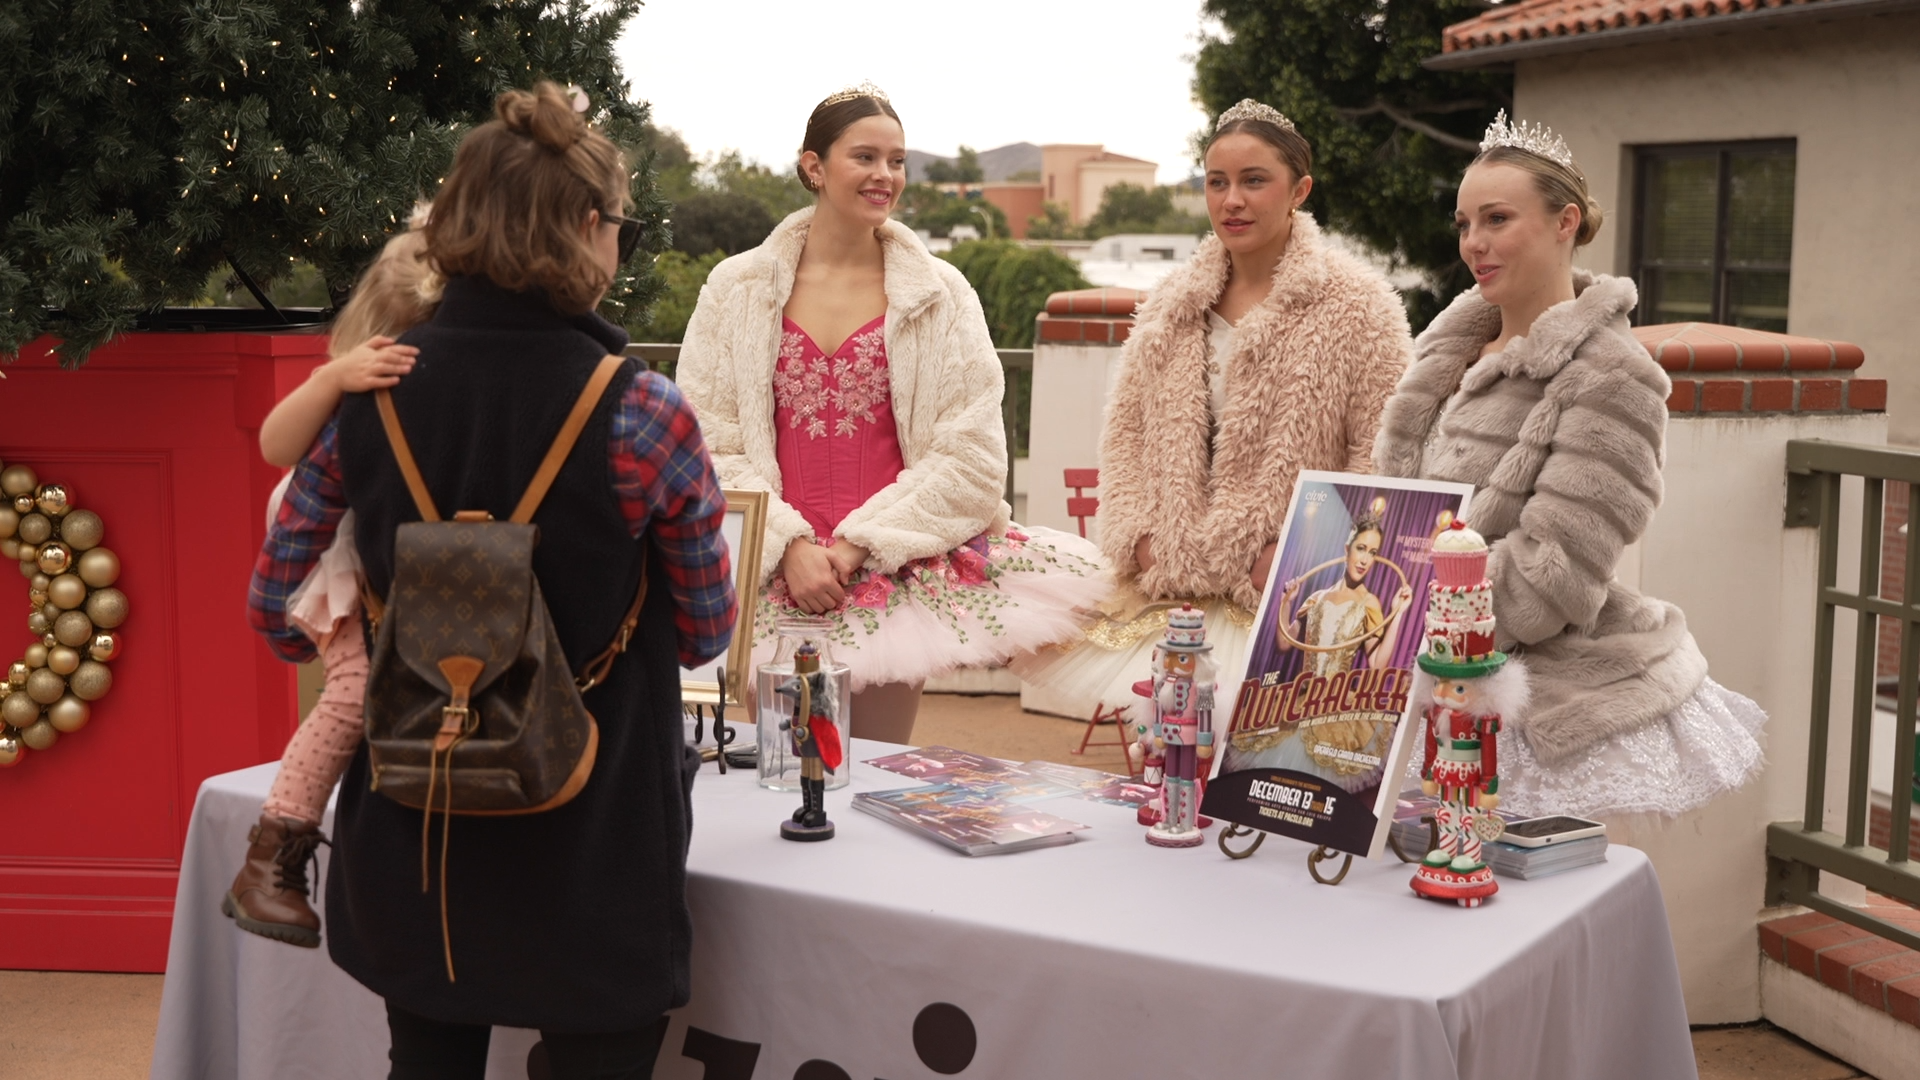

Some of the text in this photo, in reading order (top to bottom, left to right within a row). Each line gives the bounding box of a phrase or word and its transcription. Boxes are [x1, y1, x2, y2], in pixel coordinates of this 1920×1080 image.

[1305, 490, 1327, 502] civic
[1262, 670, 1280, 686] THE
[1327, 714, 1338, 723] WILL
[1338, 713, 1354, 722] NEVER
[1353, 712, 1361, 721] BE
[1361, 712, 1370, 721] THE
[1369, 712, 1384, 721] SAME
[1383, 713, 1399, 723] AGAIN
[1249, 779, 1302, 807] DECEMBER
[1301, 791, 1313, 810] 13
[1323, 796, 1336, 815] 15
[1258, 806, 1278, 818] TICKETS
[1277, 810, 1284, 820] AT
